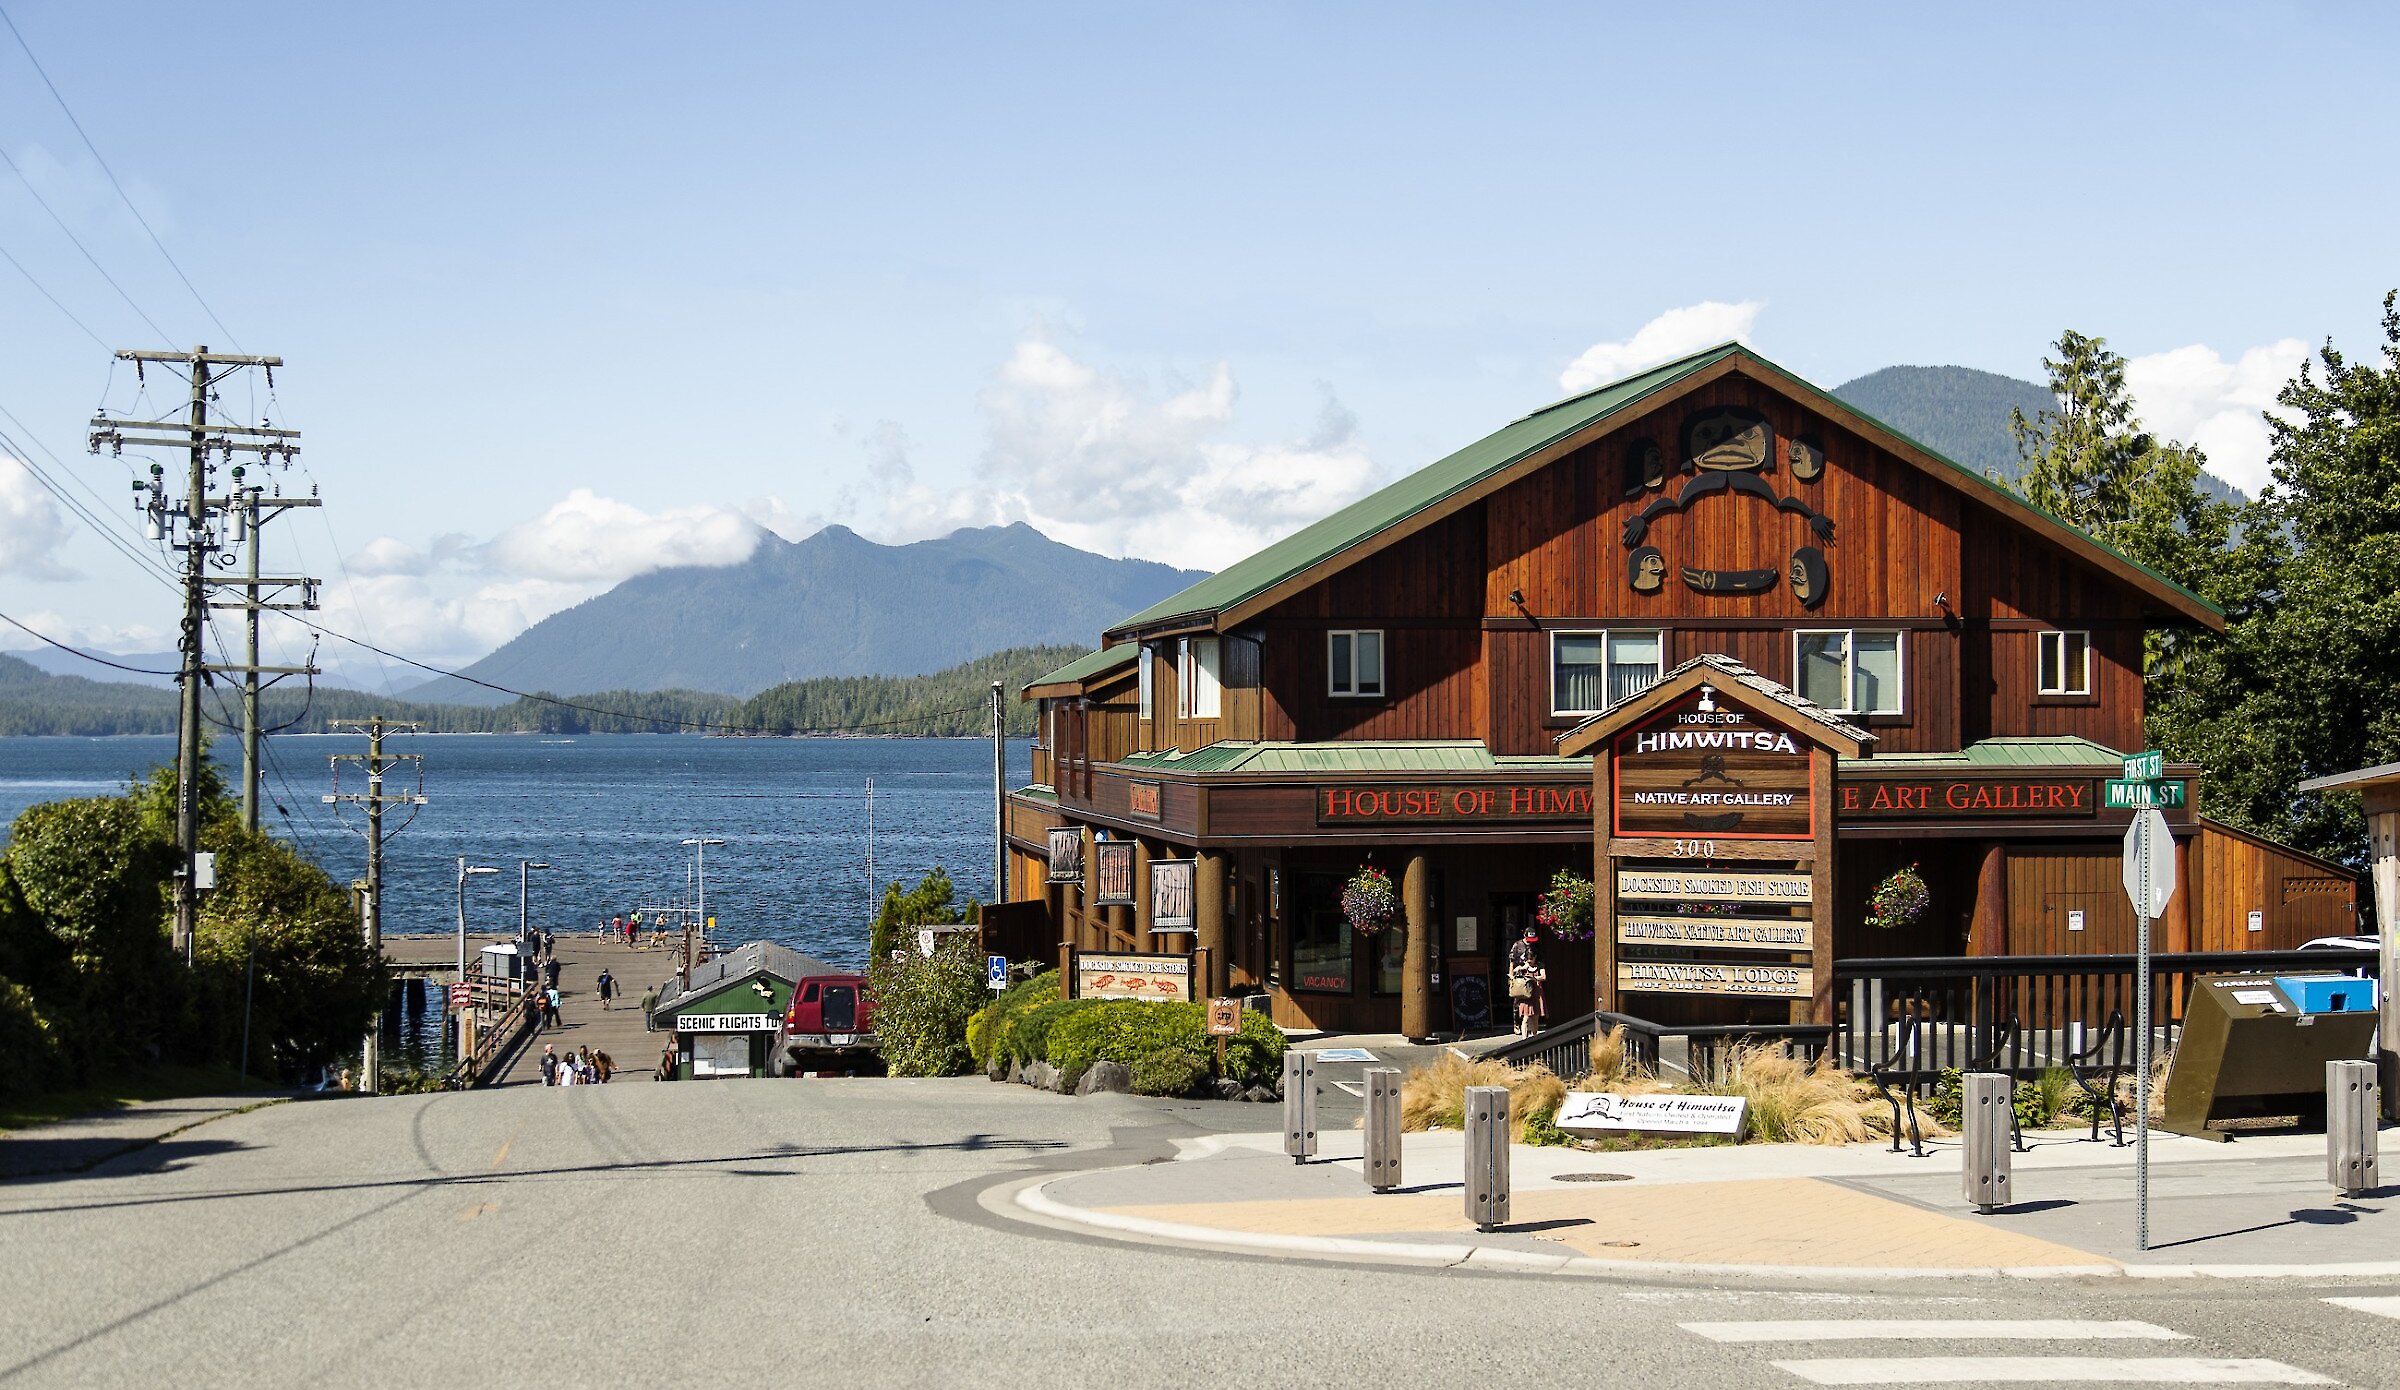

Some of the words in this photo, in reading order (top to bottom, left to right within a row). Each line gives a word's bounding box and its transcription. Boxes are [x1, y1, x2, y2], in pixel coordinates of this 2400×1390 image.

[1678, 714, 1723, 724] HOUSE
[1726, 714, 1744, 724] OF
[1637, 732, 1796, 754] HIMWITSA
[2124, 756, 2147, 779] FIRST
[2149, 755, 2160, 776] ST
[1326, 790, 1441, 816] HOUSE
[1454, 790, 1495, 815] OF
[1508, 788, 1594, 814] HIMW
[1634, 793, 1687, 804] NATIVE
[1690, 794, 1720, 805] ART
[1723, 794, 1793, 806] GALLERY
[1870, 785, 1932, 809] ART
[1946, 783, 2085, 809] GALLERY
[2111, 784, 2151, 804] MAIN
[2159, 785, 2178, 805] ST
[1672, 840, 1714, 858] 300
[1622, 877, 1680, 893] DOCKSIDE
[1685, 879, 1734, 894] SMOKED
[1736, 880, 1764, 896] FISH
[1769, 881, 1808, 896] STORE
[1625, 922, 1682, 939] HIMWITSA
[1684, 924, 1724, 941] NATIVE
[1728, 926, 1751, 942] ART
[1754, 927, 1806, 944] GALLERY
[1080, 960, 1115, 972] DOCKSIDE
[1116, 961, 1145, 972] SMOKED
[1147, 962, 1163, 974] FISH
[1164, 963, 1187, 974] STORE
[1631, 965, 1726, 982] HIMWITSA
[1733, 968, 1798, 984] LODGE
[1304, 976, 1346, 988] VACANCY
[1724, 984, 1797, 993] KITCHENS
[2213, 980, 2272, 988] GARBAGE
[680, 1017, 715, 1030] SCENIC
[720, 1016, 760, 1028] FLIGHTS
[1619, 1098, 1655, 1109] House
[1659, 1100, 1674, 1112] of
[1676, 1100, 1736, 1112] Himwitsa
